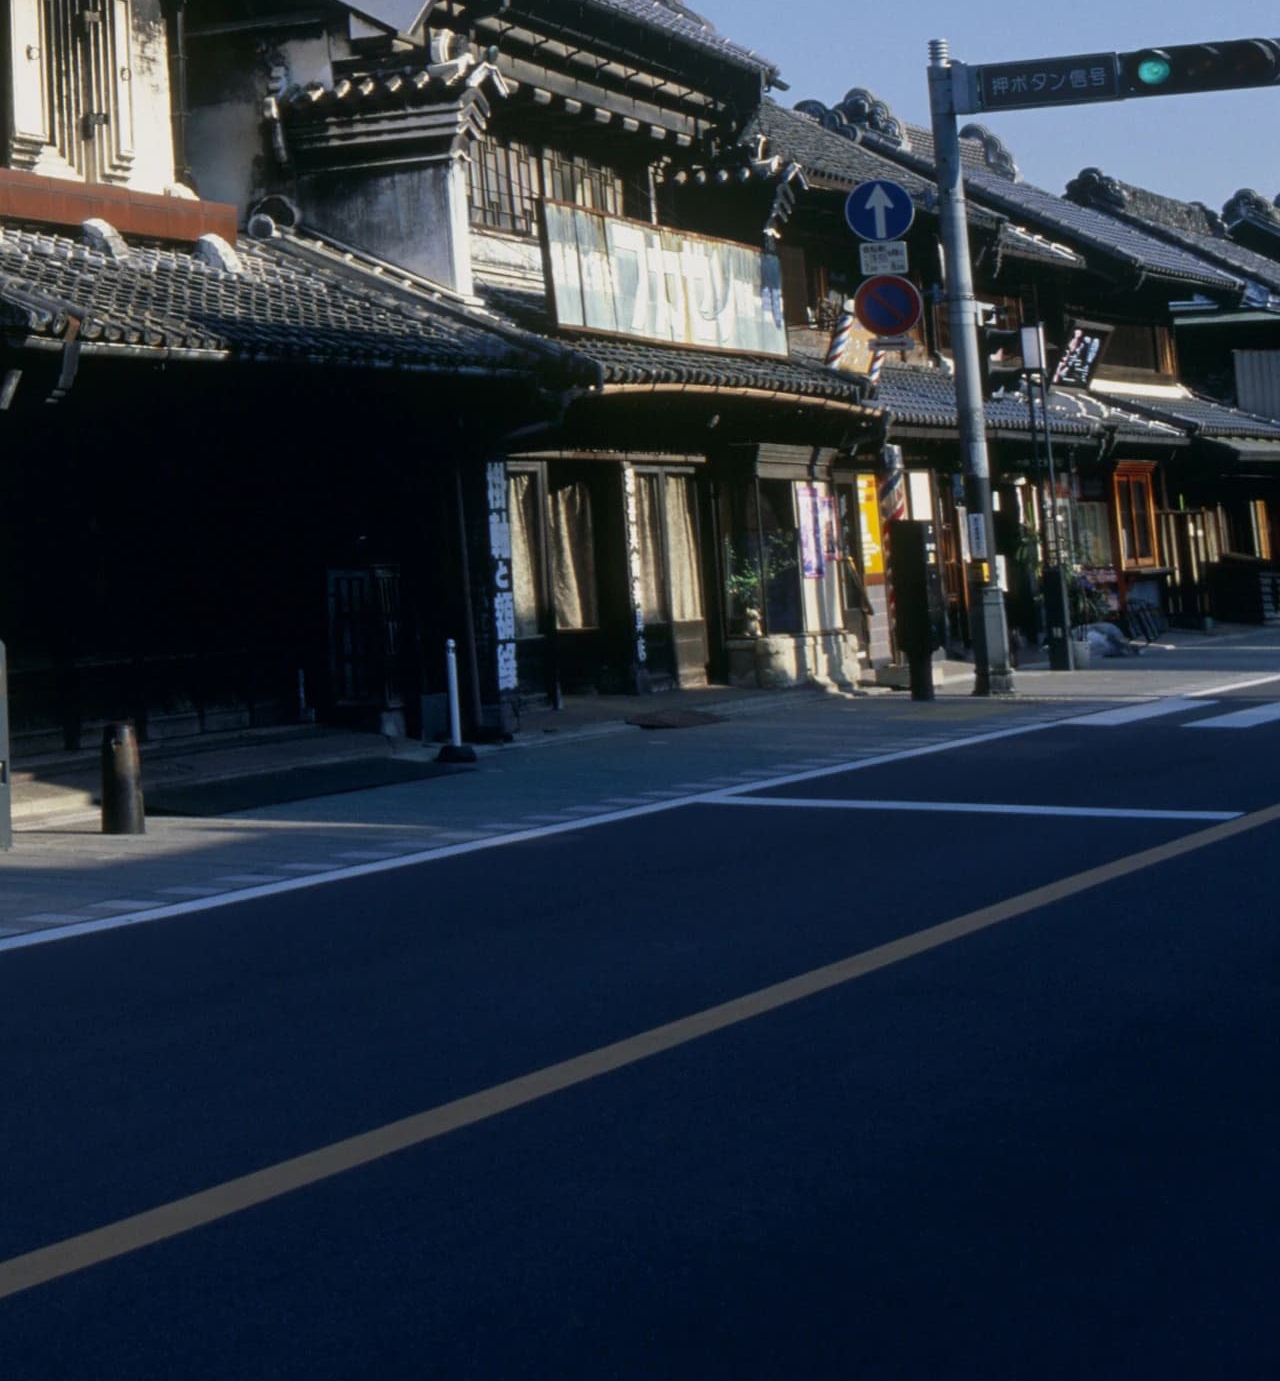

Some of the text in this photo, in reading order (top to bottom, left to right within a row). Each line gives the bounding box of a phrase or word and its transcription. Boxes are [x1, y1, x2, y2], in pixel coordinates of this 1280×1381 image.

[991, 66, 1106, 95] 押ボタン信号
